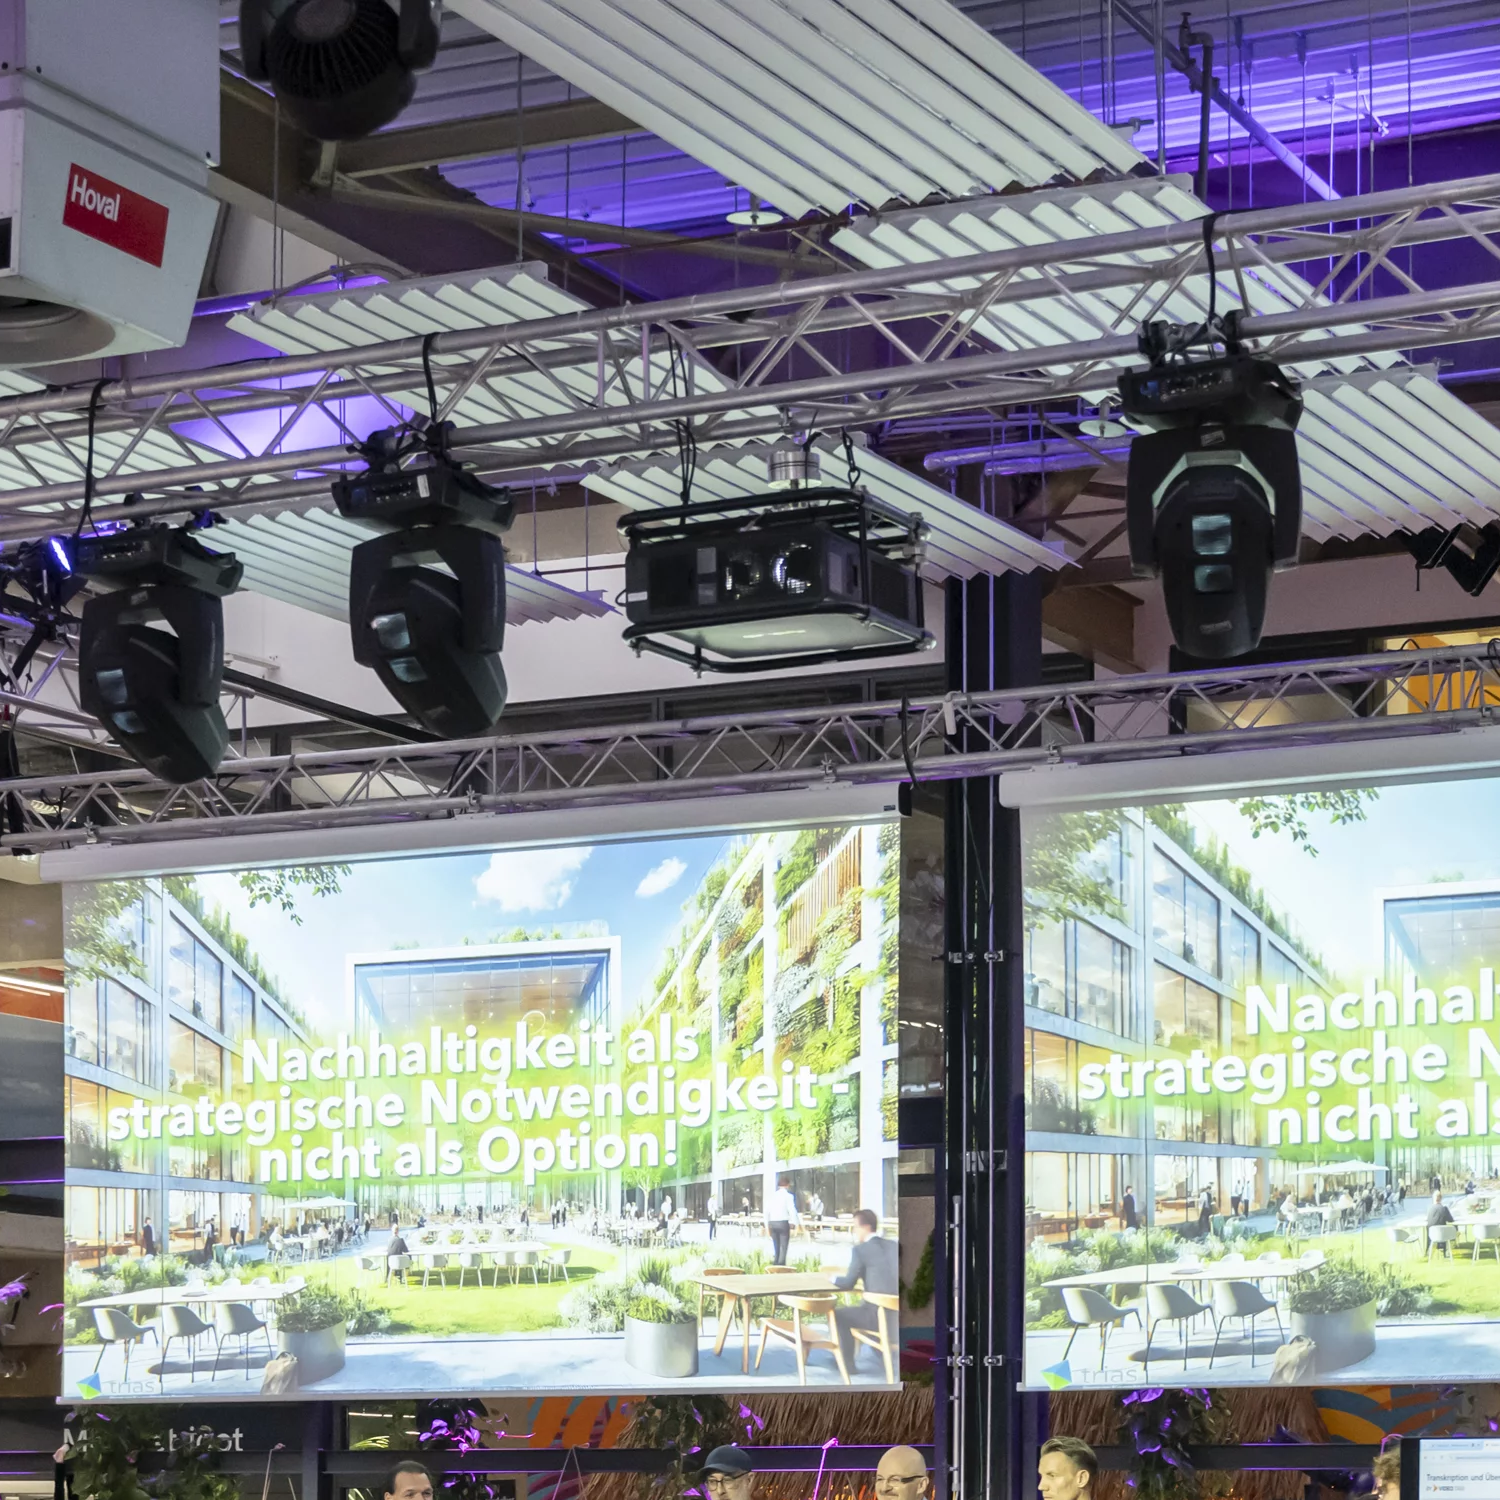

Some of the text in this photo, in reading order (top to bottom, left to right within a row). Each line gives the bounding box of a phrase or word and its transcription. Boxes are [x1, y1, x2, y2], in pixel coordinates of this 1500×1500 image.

[71, 174, 120, 222] Hoval
[242, 1012, 700, 1086] Nachhaltigkeit als
[1078, 1029, 1448, 1107] strategische
[107, 1080, 406, 1146] strategische
[420, 1061, 819, 1136] Notwendigkeit
[1266, 1081, 1420, 1145] nicht
[259, 1118, 680, 1184] nicht als Option!
[109, 1379, 155, 1394] trias
[1081, 1366, 1138, 1384] trias
[1427, 1473, 1469, 1482] Transkription
[1470, 1474, 1484, 1482] und
